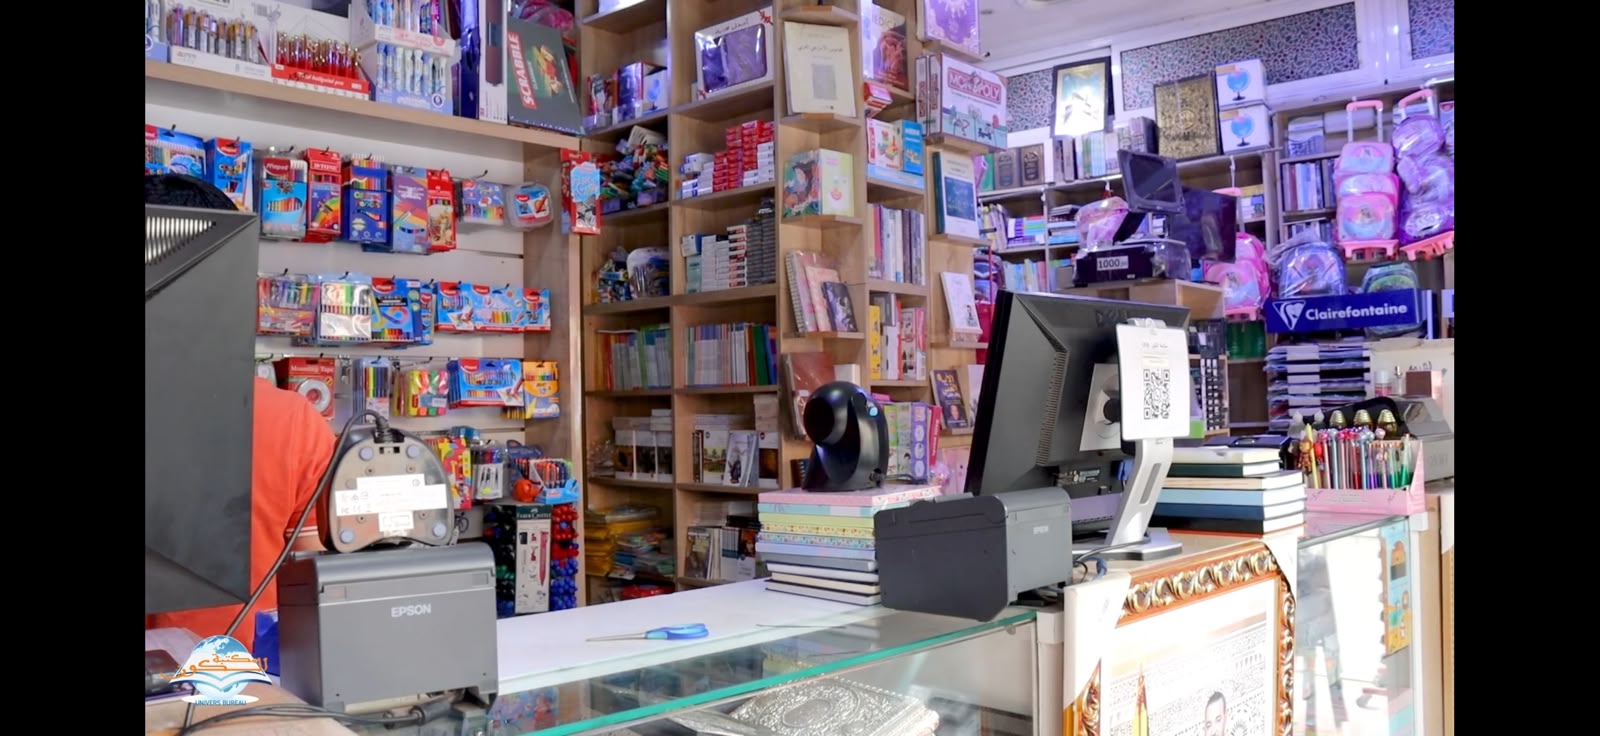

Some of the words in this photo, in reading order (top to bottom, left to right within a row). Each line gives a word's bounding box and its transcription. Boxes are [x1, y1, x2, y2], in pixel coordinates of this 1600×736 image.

[508, 33, 536, 106] SCRABBLE
[1098, 258, 1120, 269] 1000
[1305, 303, 1408, 321] Clairefontaine
[391, 603, 432, 618] EPSON
